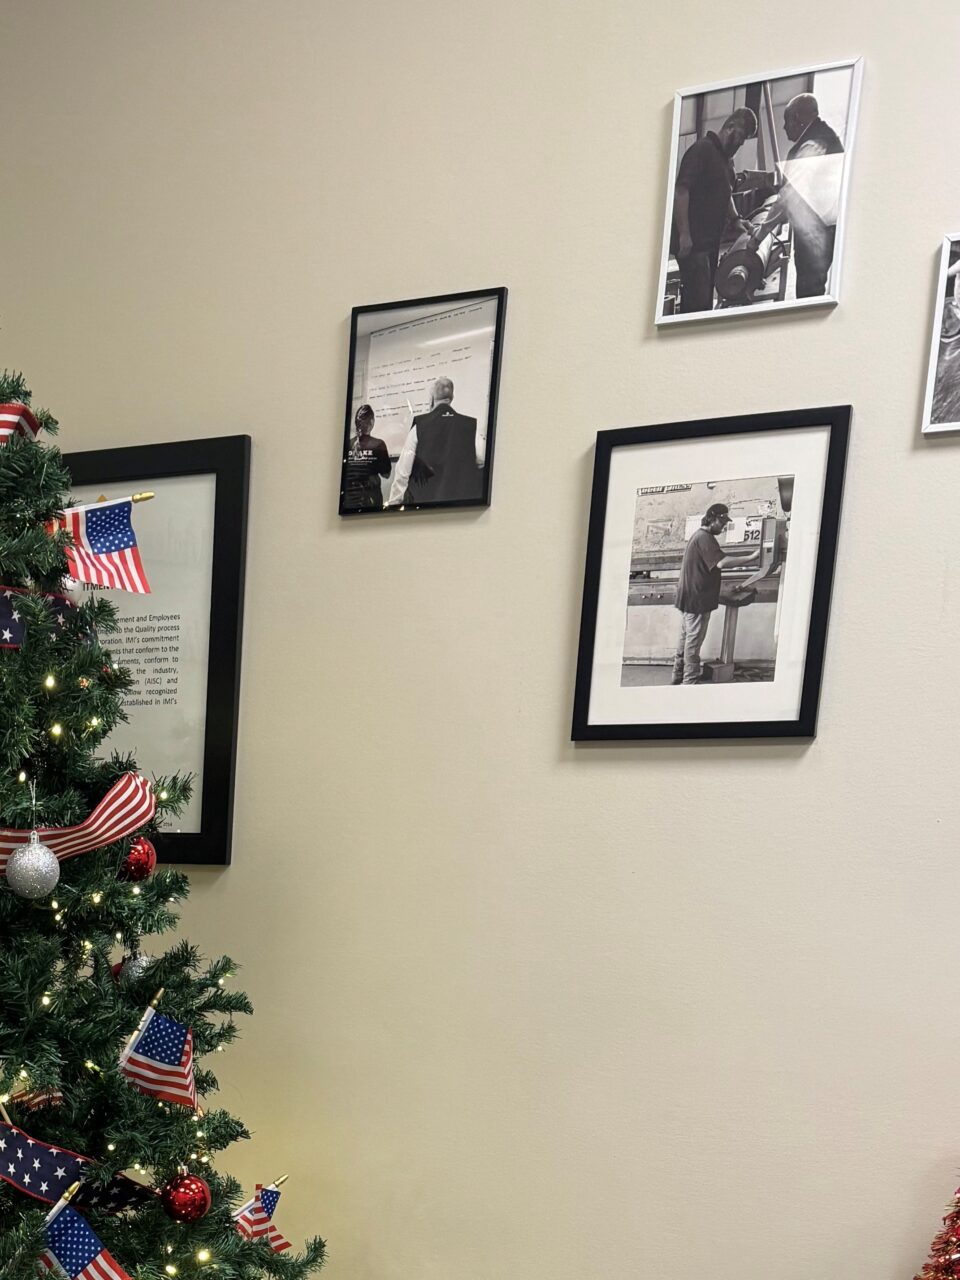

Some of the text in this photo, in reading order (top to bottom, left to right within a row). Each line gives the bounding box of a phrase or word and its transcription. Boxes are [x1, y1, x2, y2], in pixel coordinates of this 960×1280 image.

[744, 530, 761, 541] 512
[136, 613, 180, 624] and Employees
[135, 624, 156, 634] Quality
[157, 624, 180, 632] process
[141, 635, 179, 643] commitment
[135, 646, 160, 654] conform
[144, 656, 169, 664] conform
[145, 687, 178, 696] recognized
[155, 697, 161, 705] in
